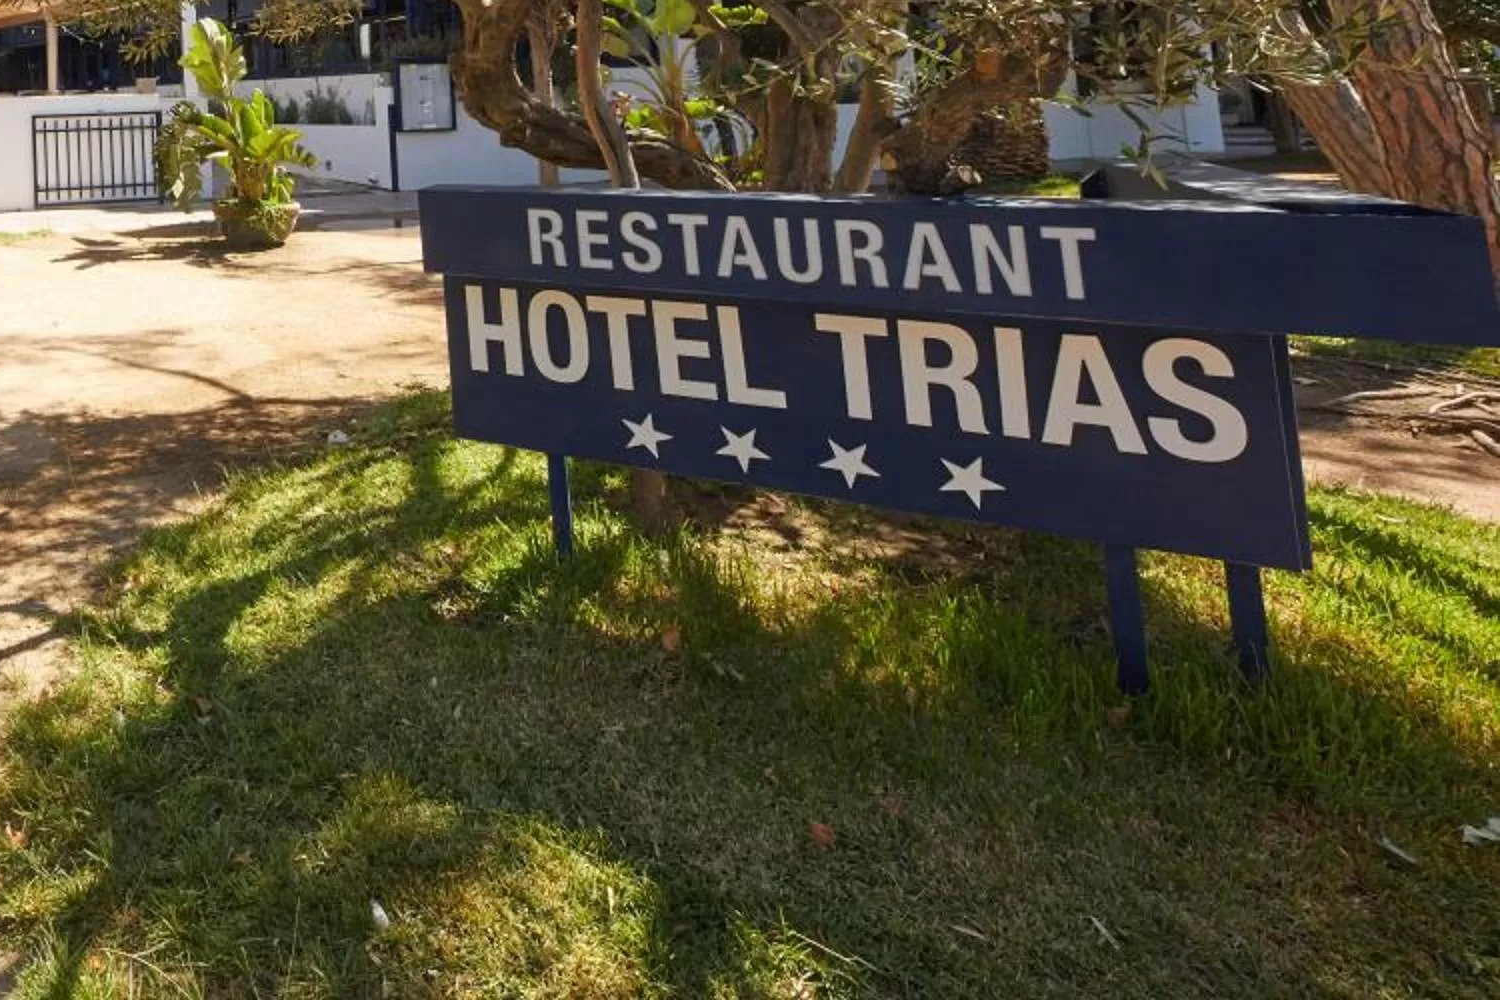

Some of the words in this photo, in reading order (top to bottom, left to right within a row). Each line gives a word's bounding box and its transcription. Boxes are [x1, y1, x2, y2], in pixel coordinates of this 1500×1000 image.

[527, 209, 1097, 300] RESTAURANT
[463, 285, 788, 410] HOTEL
[815, 313, 1248, 463] TRIAS
